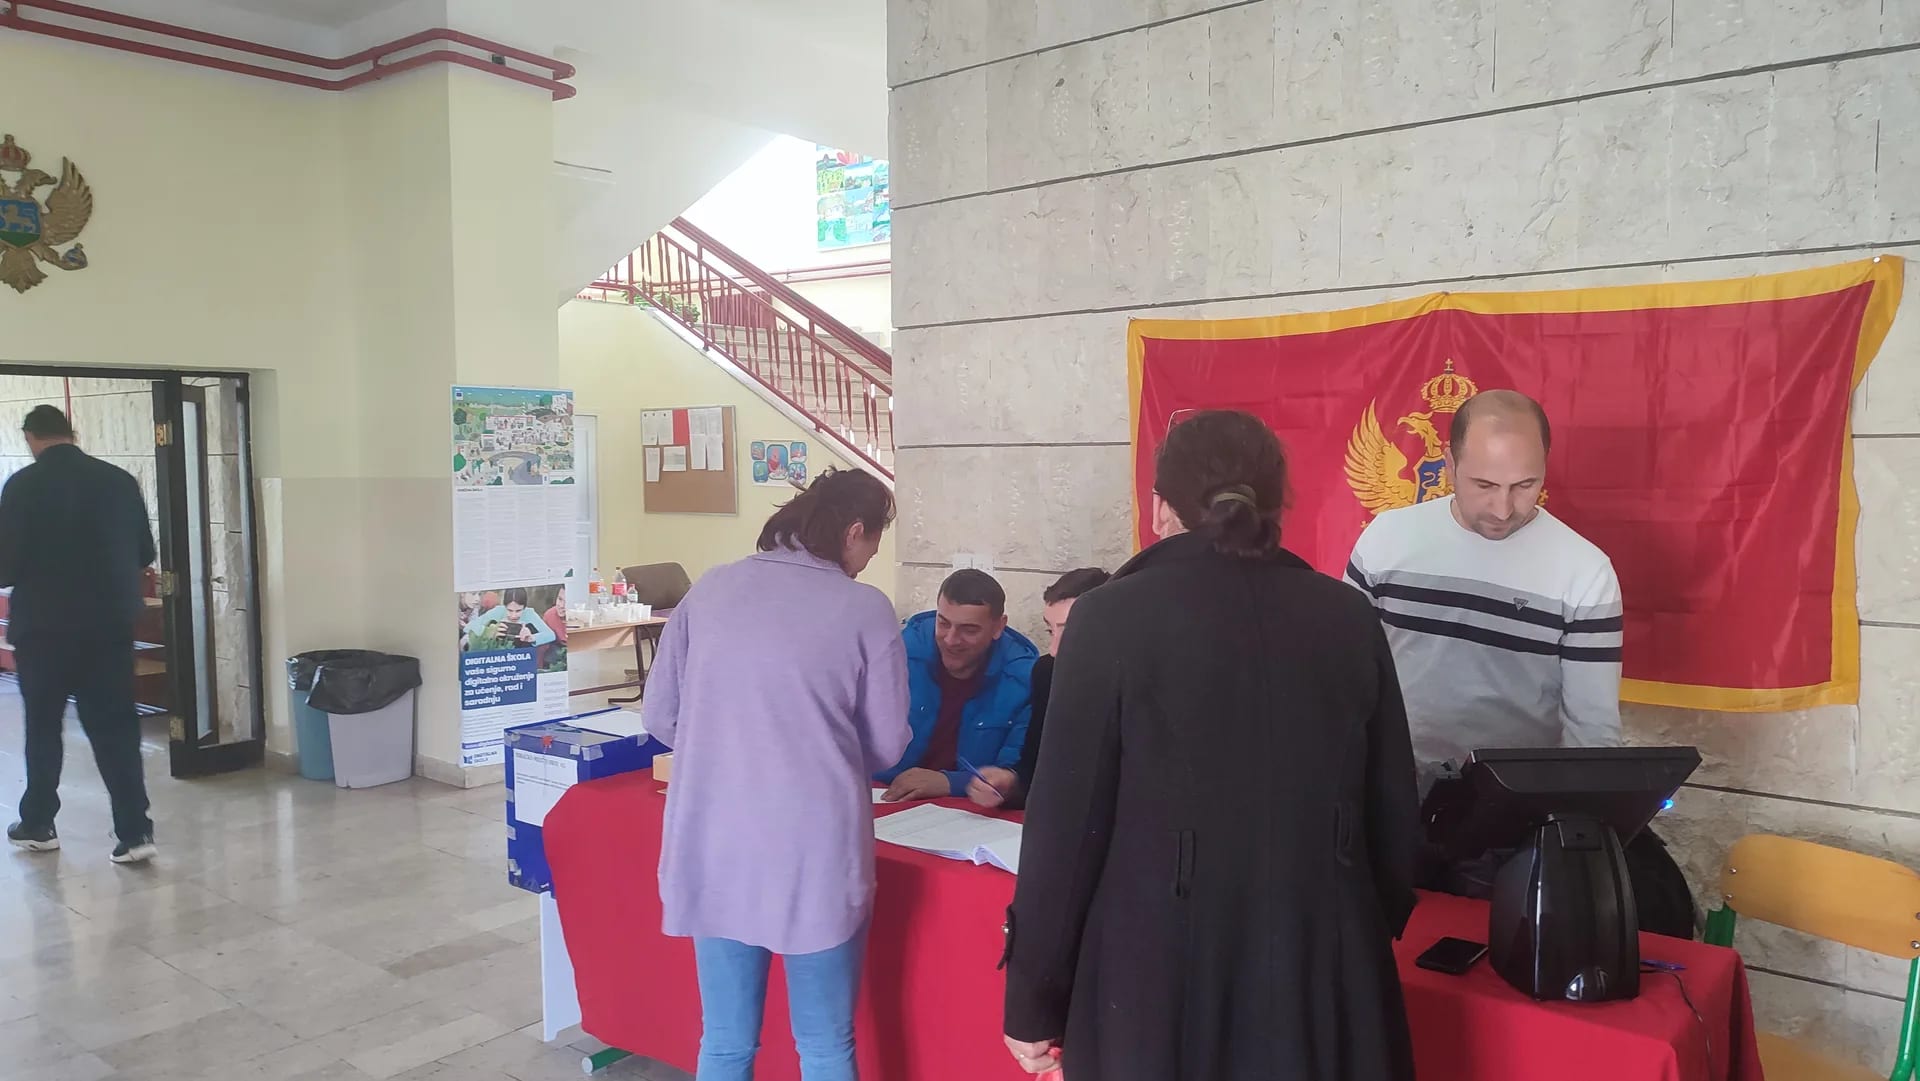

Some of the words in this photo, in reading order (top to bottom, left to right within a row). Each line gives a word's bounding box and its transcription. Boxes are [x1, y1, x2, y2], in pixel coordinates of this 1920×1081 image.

[465, 656, 506, 665] DIGITALNA
[507, 653, 531, 662] ŠKOLA
[486, 665, 516, 675] sigurno
[465, 676, 499, 687] digitalno
[499, 672, 535, 681] okruženje
[475, 685, 504, 695] učenje,
[505, 683, 519, 691] rad
[464, 695, 501, 706] saradnju
